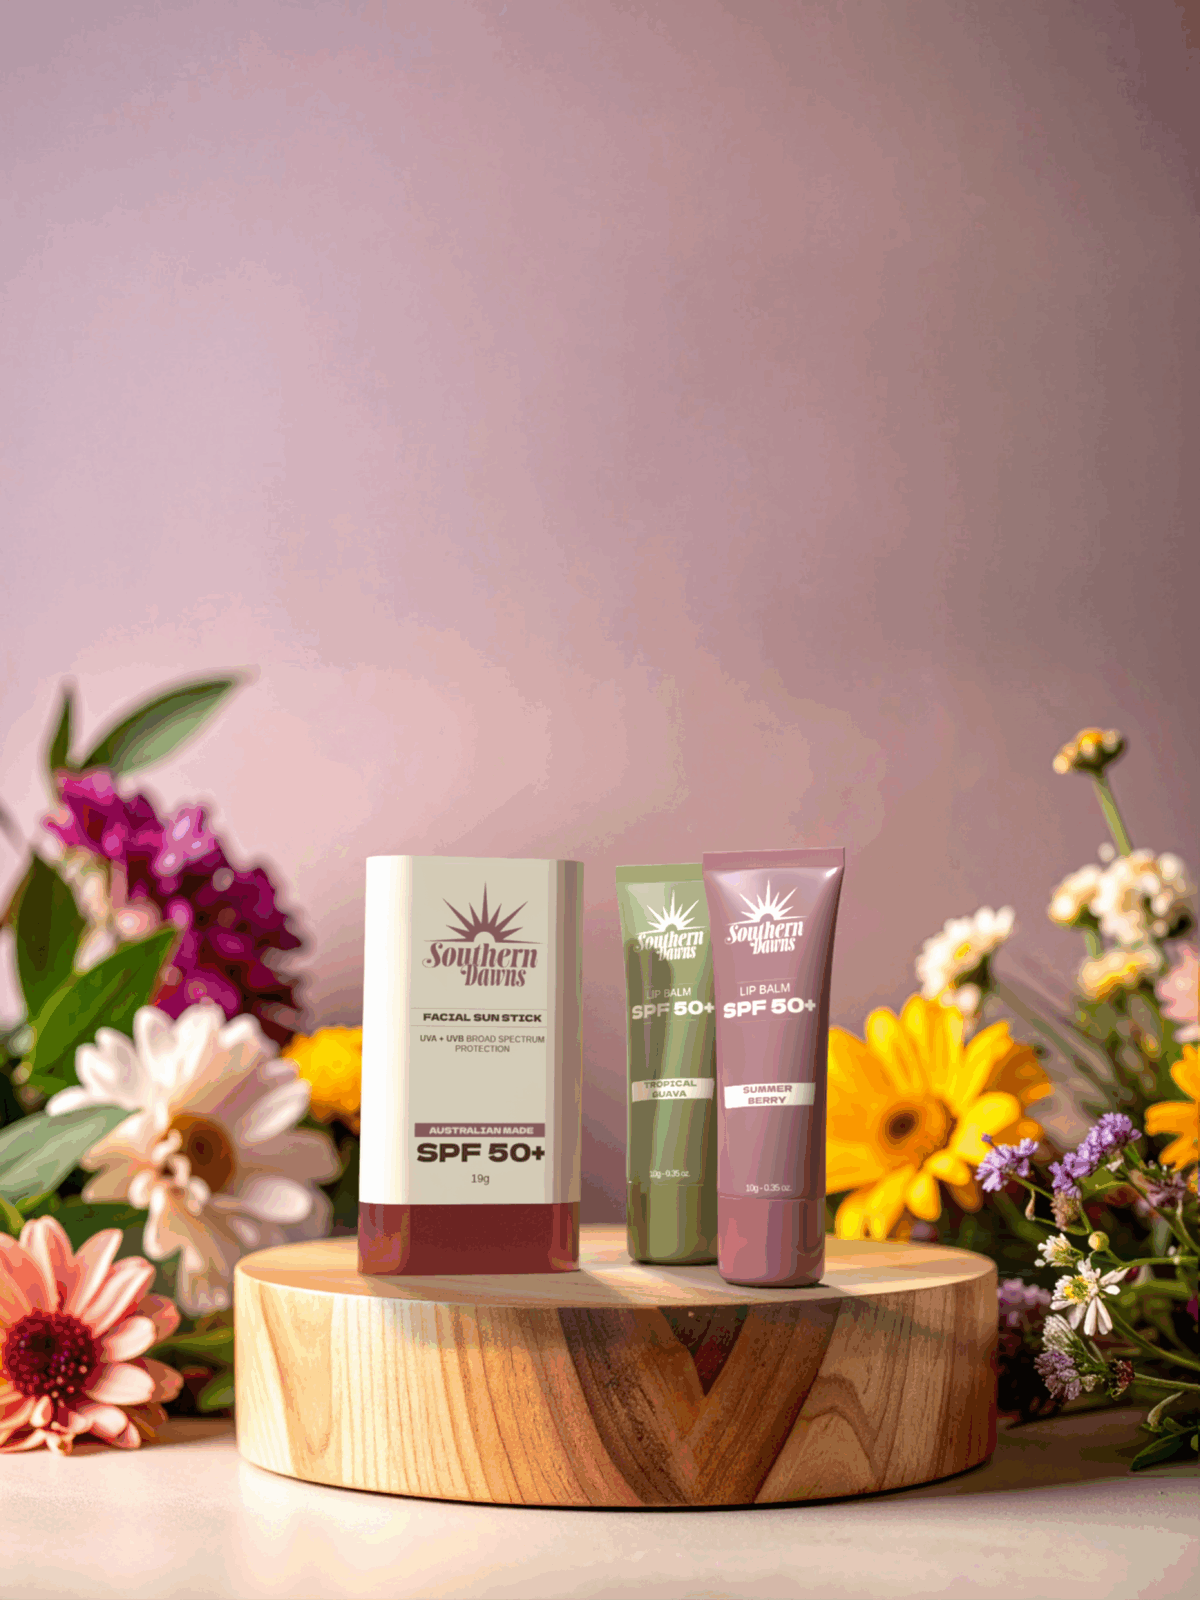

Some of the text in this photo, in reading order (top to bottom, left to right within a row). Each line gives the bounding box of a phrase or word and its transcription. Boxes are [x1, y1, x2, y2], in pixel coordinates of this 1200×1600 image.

[724, 921, 804, 945] Southern
[634, 931, 704, 953] Southern
[749, 937, 796, 955] Dawns
[422, 942, 539, 968] Southern
[460, 963, 527, 987] Dawns
[664, 987, 691, 998] BALM
[740, 983, 790, 996] LIP BALM
[632, 1000, 714, 1020] SPF 50+
[723, 997, 816, 1018] SPF 50+
[423, 1013, 542, 1022] FACIAL SUN STICK
[420, 1034, 437, 1042] UVA
[446, 1034, 464, 1042] UVB
[466, 1034, 496, 1043] BROAD
[498, 1034, 545, 1043] SPECTRUM
[455, 1044, 510, 1053] PROTECTION
[644, 1080, 697, 1089] TROPICAL
[743, 1085, 793, 1094] SUMMER
[652, 1090, 687, 1098] GUAVA
[748, 1096, 787, 1105] BERRY
[429, 1126, 535, 1135] AUSTRALIAN MADE
[416, 1142, 545, 1163] SPF 50+
[471, 1173, 490, 1186] 19g
